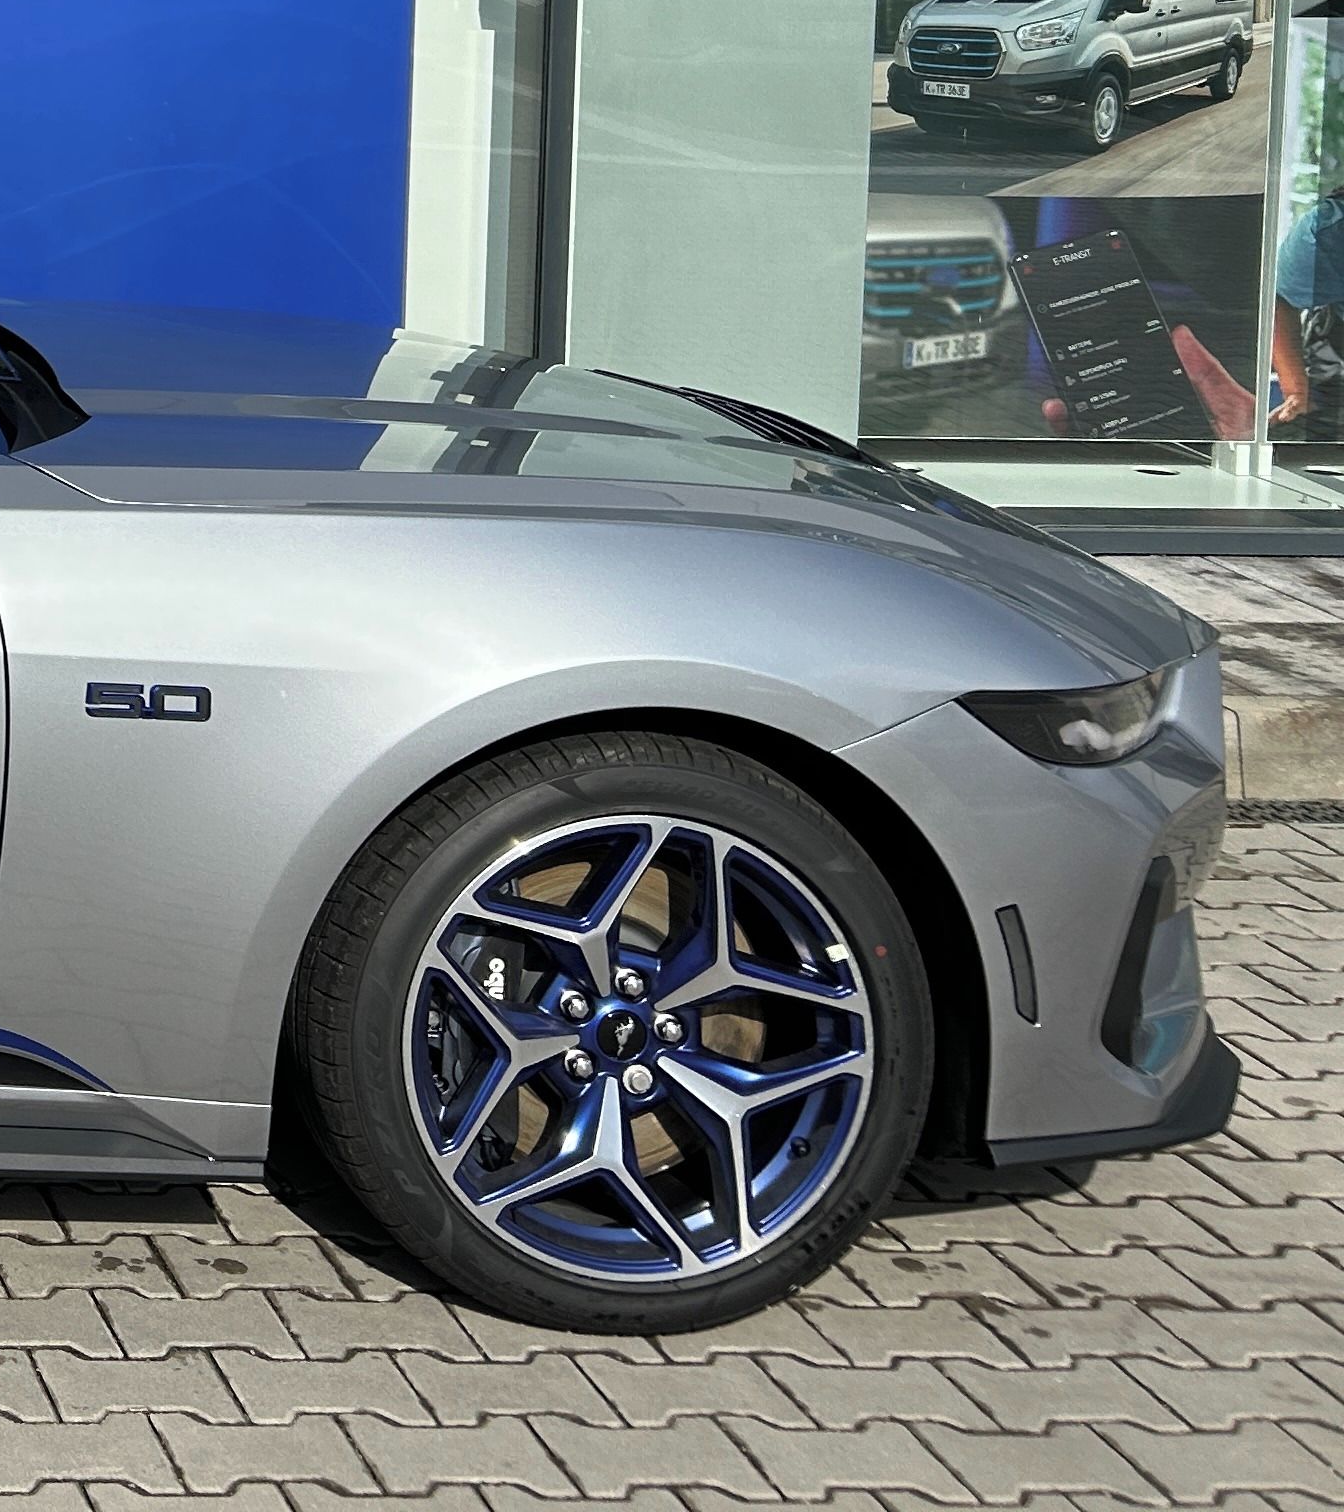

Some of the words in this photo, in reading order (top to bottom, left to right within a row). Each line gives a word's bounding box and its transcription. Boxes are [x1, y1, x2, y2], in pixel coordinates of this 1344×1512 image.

[1051, 248, 1093, 266] E-TRANSIT
[84, 681, 212, 722] 5.0
[483, 956, 506, 1000] mbo
